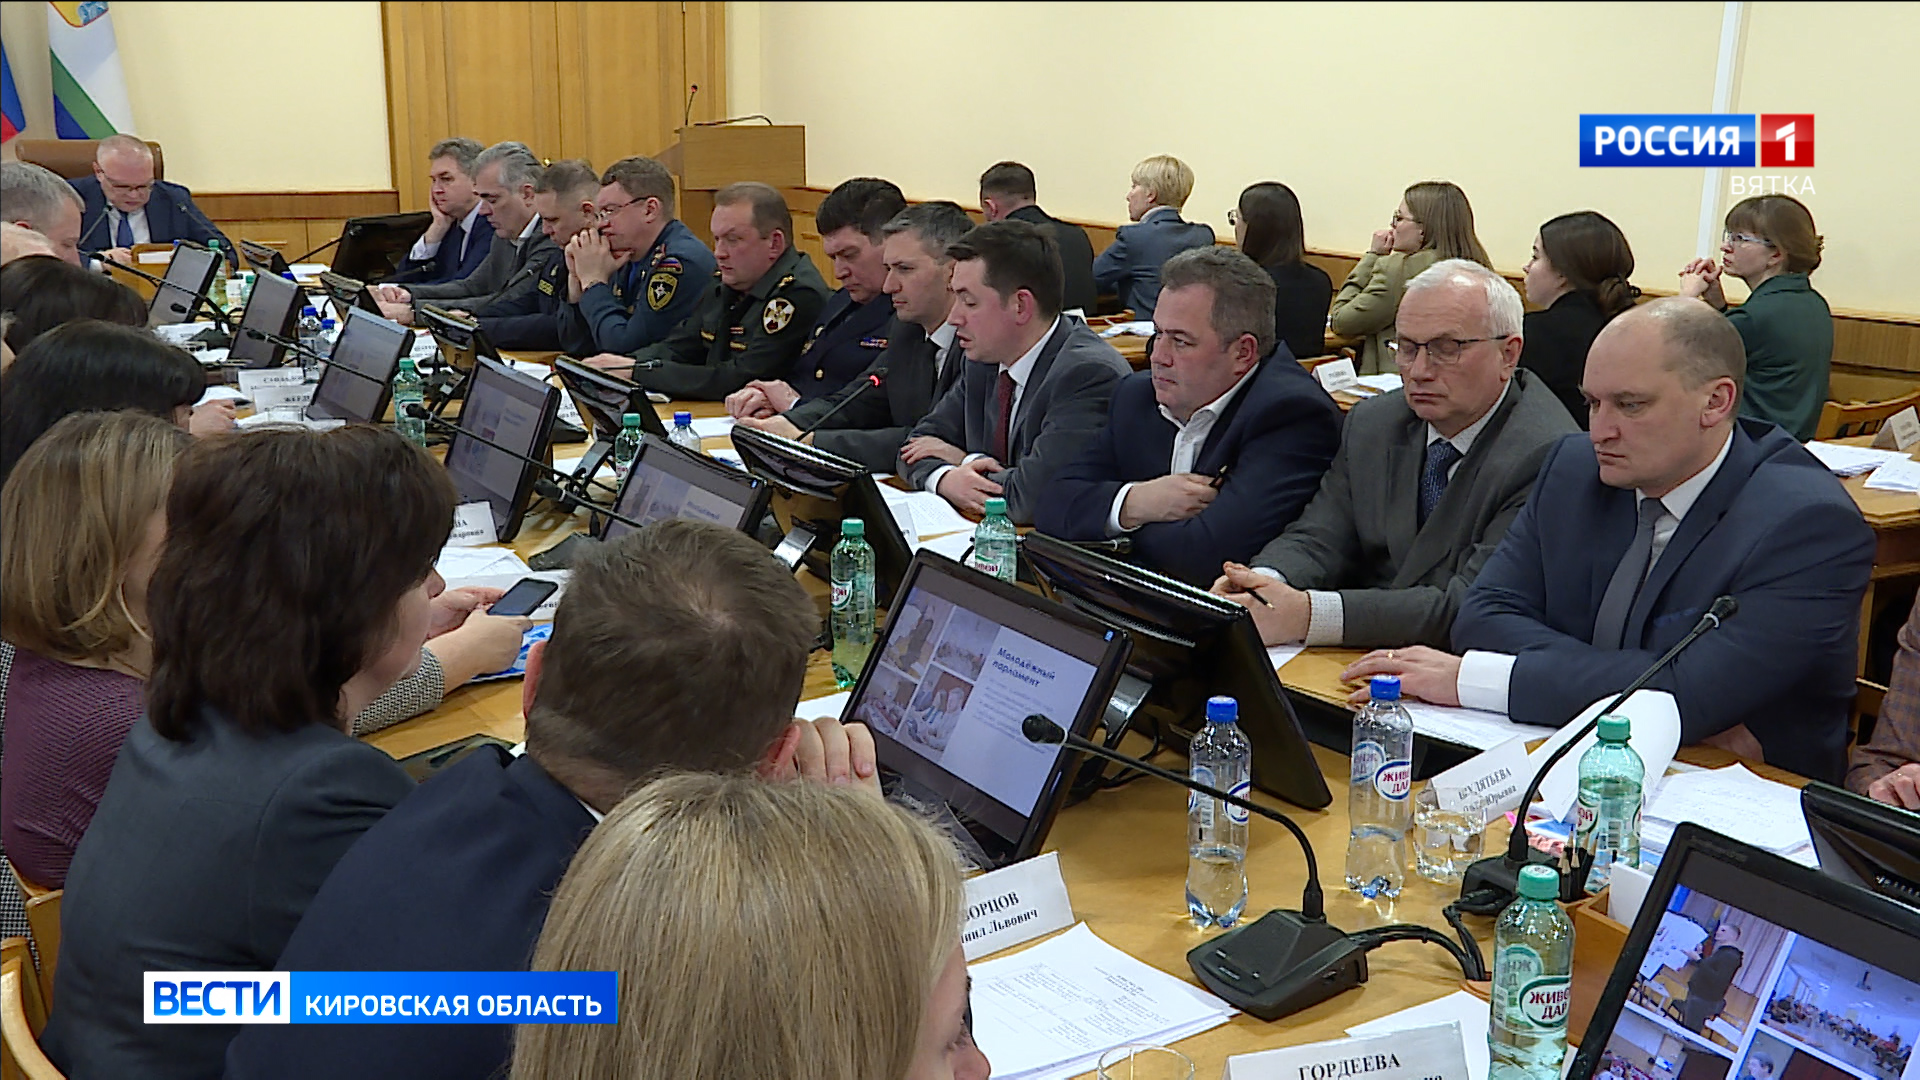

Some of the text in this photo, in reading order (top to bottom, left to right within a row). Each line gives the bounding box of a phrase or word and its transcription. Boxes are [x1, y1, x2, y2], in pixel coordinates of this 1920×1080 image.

[992, 660, 1041, 687] парламент
[967, 891, 1020, 921] ОРЦОВ
[989, 909, 1038, 934] Львович
[1298, 1053, 1401, 1080] ГОРДЕЕВА
